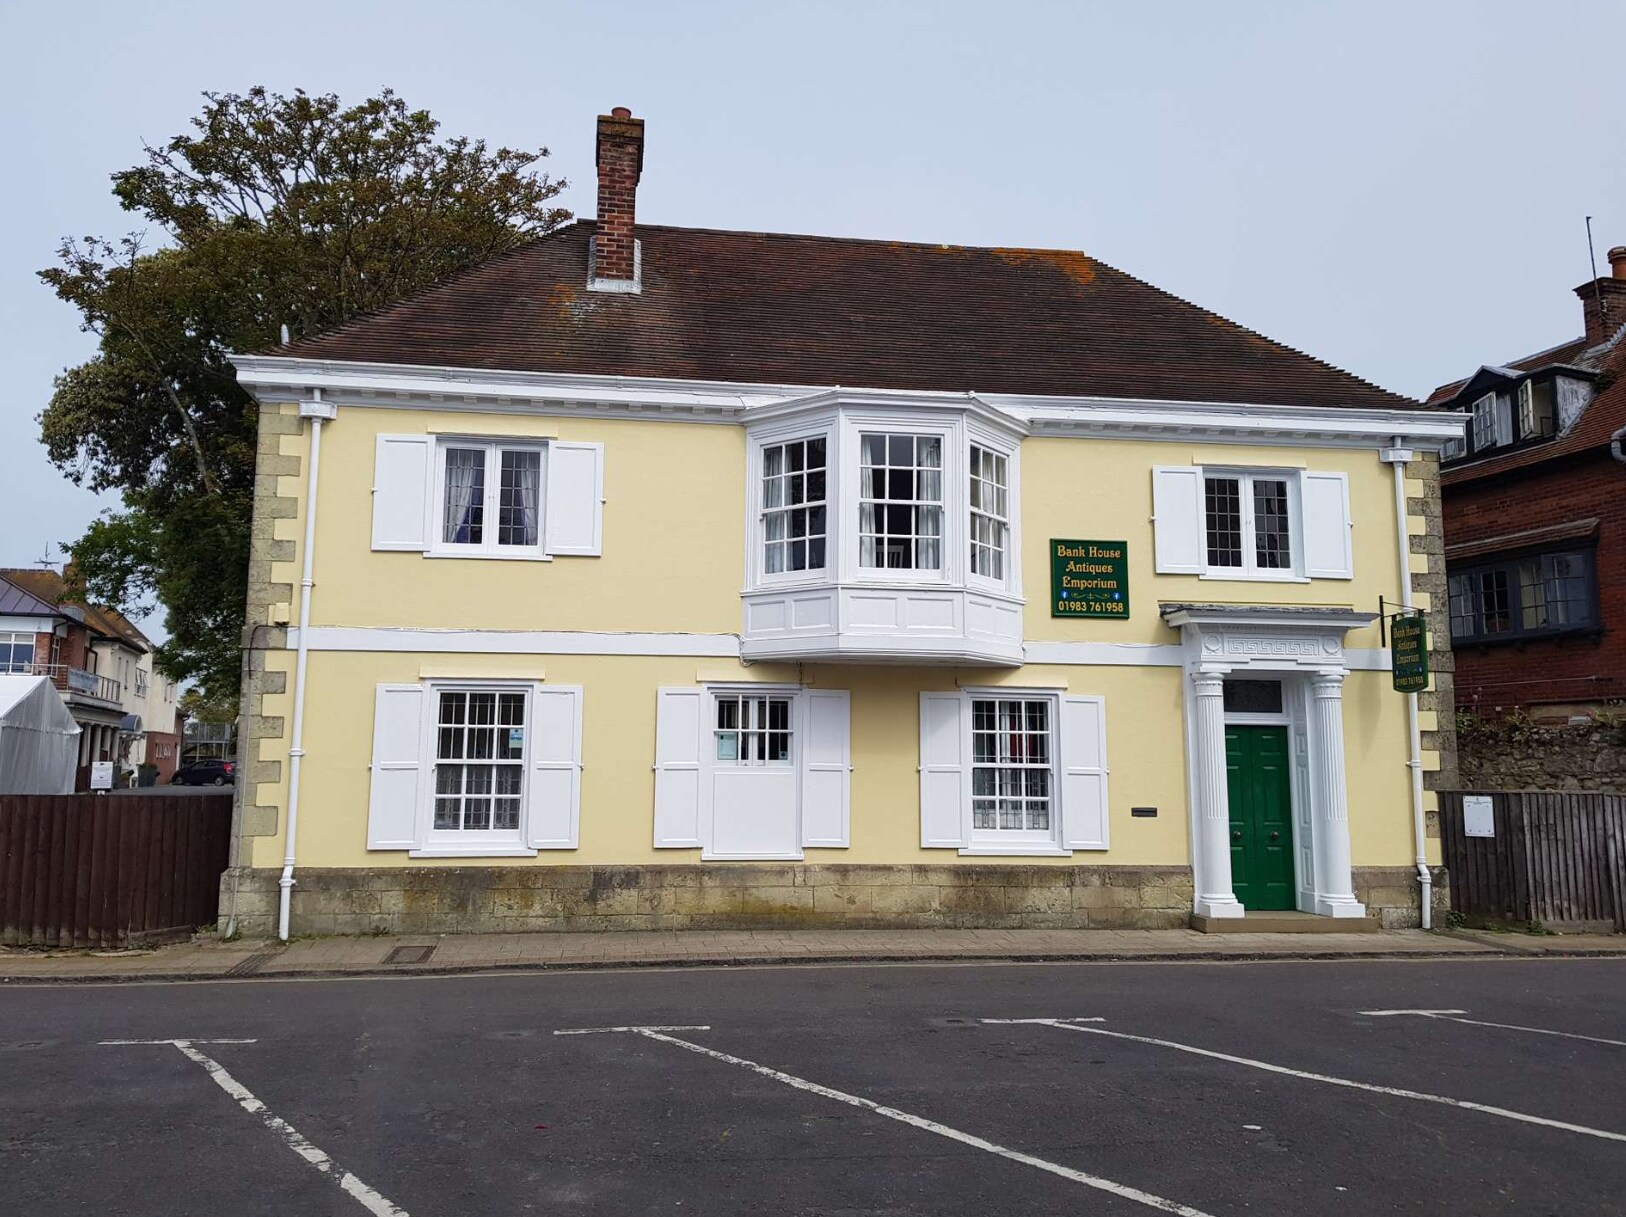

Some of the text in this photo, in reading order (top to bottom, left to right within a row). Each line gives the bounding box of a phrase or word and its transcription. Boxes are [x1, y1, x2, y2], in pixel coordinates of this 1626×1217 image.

[1058, 545, 1121, 558] Bank House
[1066, 561, 1113, 575] Antiques
[1062, 576, 1117, 590] Emporium
[1058, 601, 1124, 612] 01983 761958
